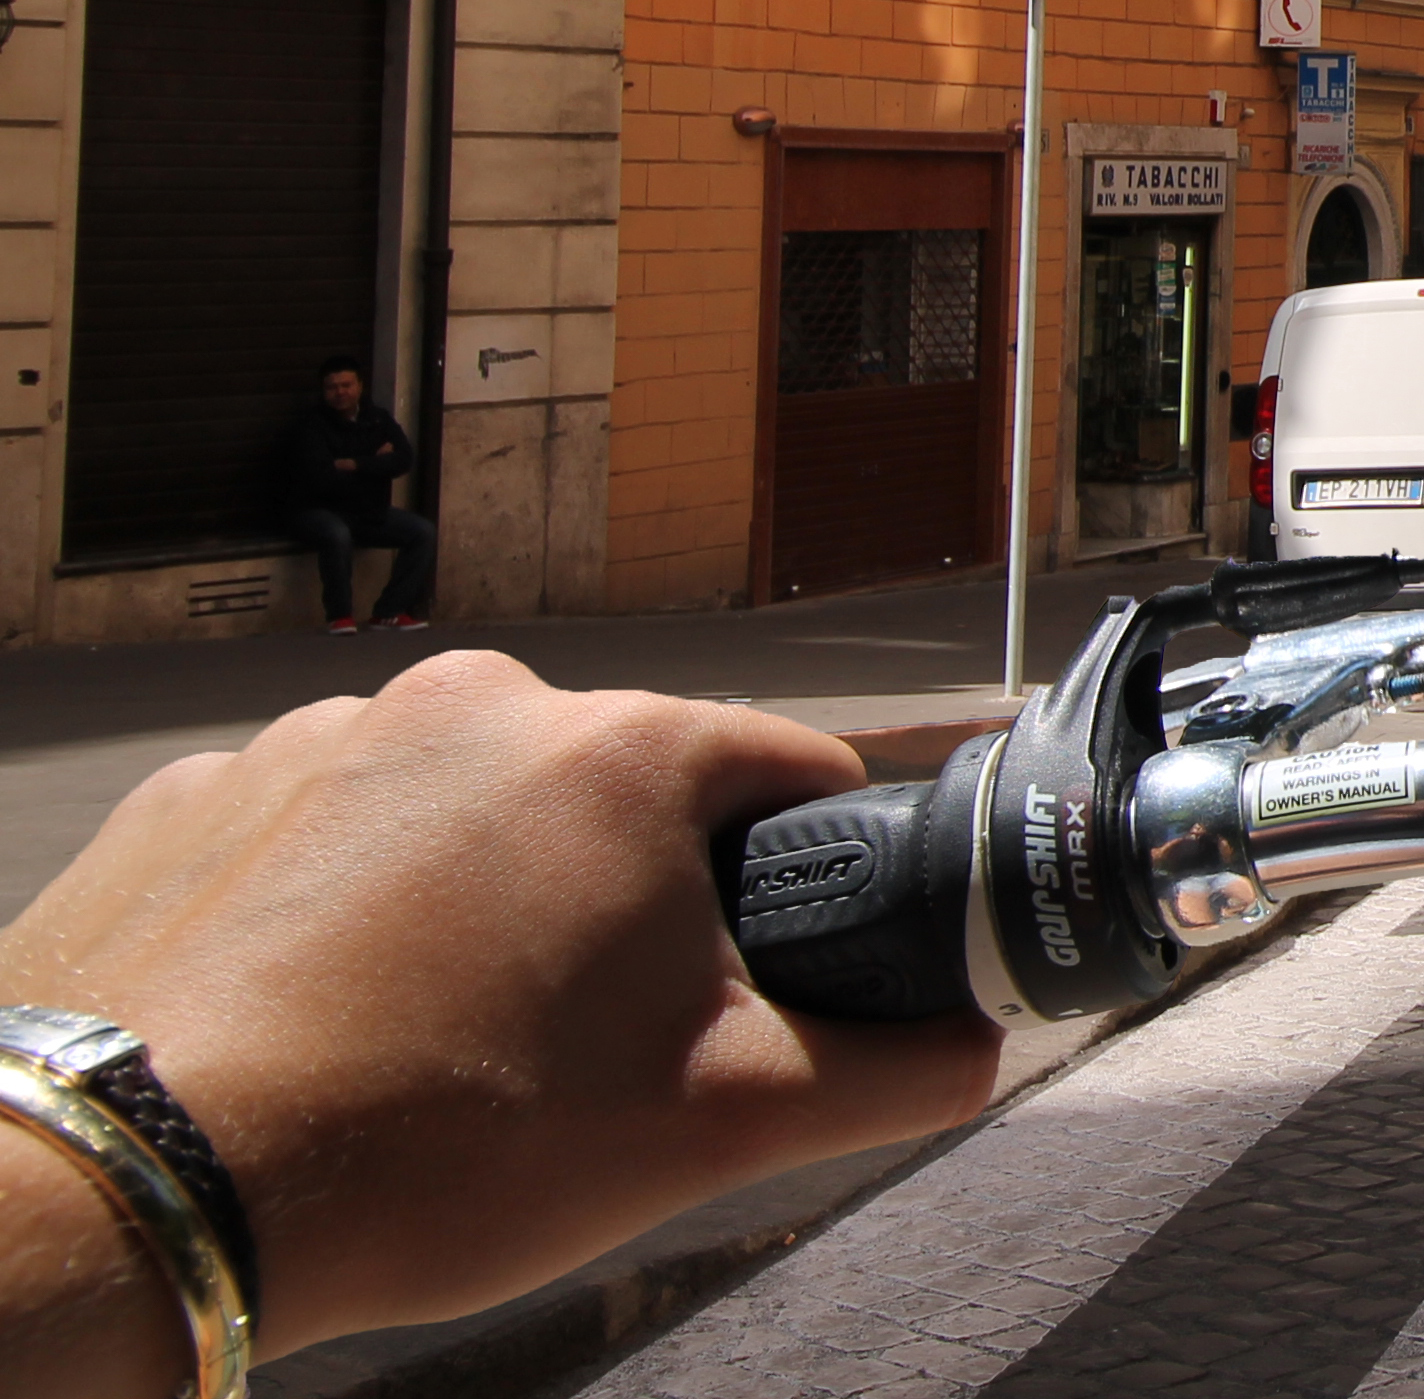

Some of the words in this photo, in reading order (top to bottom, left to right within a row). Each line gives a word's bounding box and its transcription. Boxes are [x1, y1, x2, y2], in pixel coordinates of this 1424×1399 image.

[1307, 58, 1339, 98] T
[1348, 58, 1356, 168] TABACCHI
[1298, 153, 1345, 163] TELEFONICHE
[1303, 145, 1340, 154] RICARICHE
[1126, 165, 1219, 188] TABACCHI
[1097, 193, 1117, 206] RIV.
[1149, 193, 1184, 206] VALORI
[1187, 193, 1223, 205] BOLLATI
[1319, 481, 1341, 500] EP
[1349, 480, 1410, 499] 211VH
[1292, 745, 1379, 763] CAUTION
[1283, 762, 1322, 775] READ
[1328, 754, 1381, 768] AFETY
[1282, 770, 1361, 790] WARNINGS
[1265, 790, 1334, 812] OWNER'S
[1338, 781, 1401, 801] MANUAL
